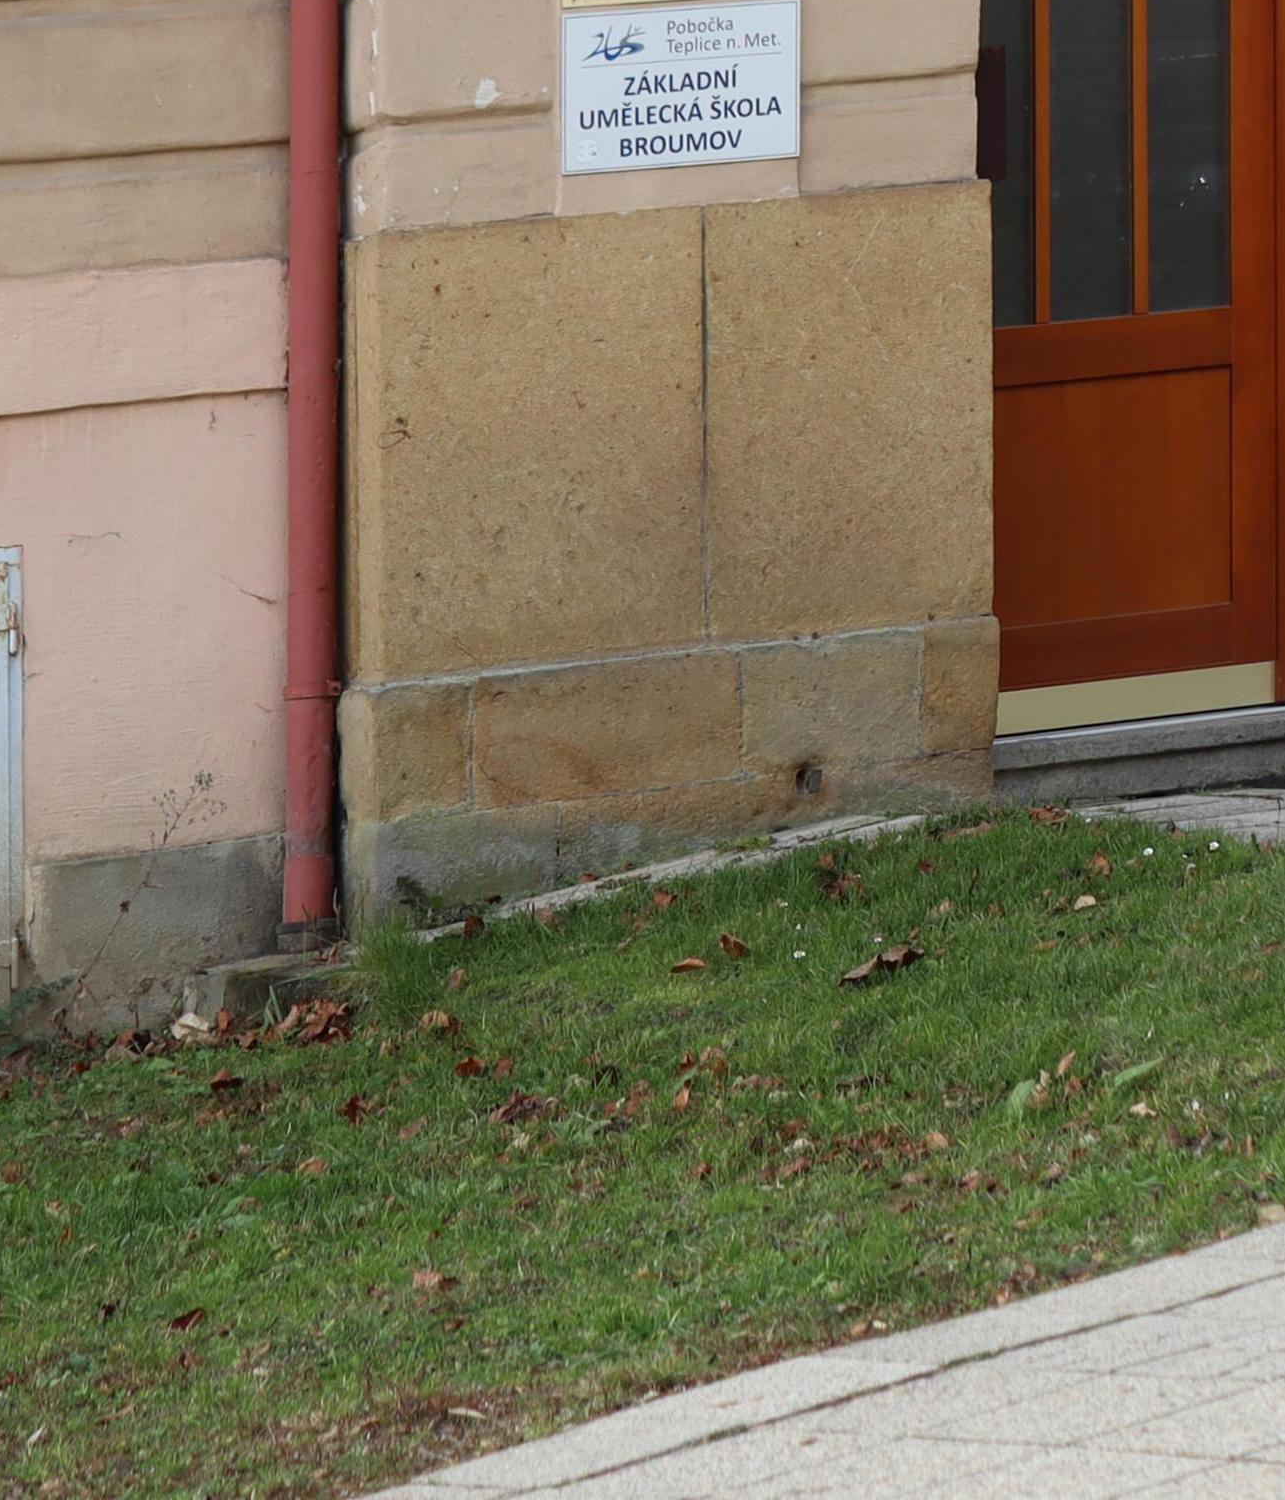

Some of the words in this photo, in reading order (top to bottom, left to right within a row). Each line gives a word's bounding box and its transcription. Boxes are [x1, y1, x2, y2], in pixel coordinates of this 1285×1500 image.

[667, 17, 734, 35] Pobočka
[667, 37, 721, 55] Teplice
[726, 36, 740, 49] n.
[744, 33, 782, 48] Met.
[624, 64, 738, 96] ZÁKLADNÍ
[579, 97, 703, 130] UMĚLECKÁ
[710, 96, 781, 121] ŠKOLA
[620, 130, 742, 158] BROUMOV
